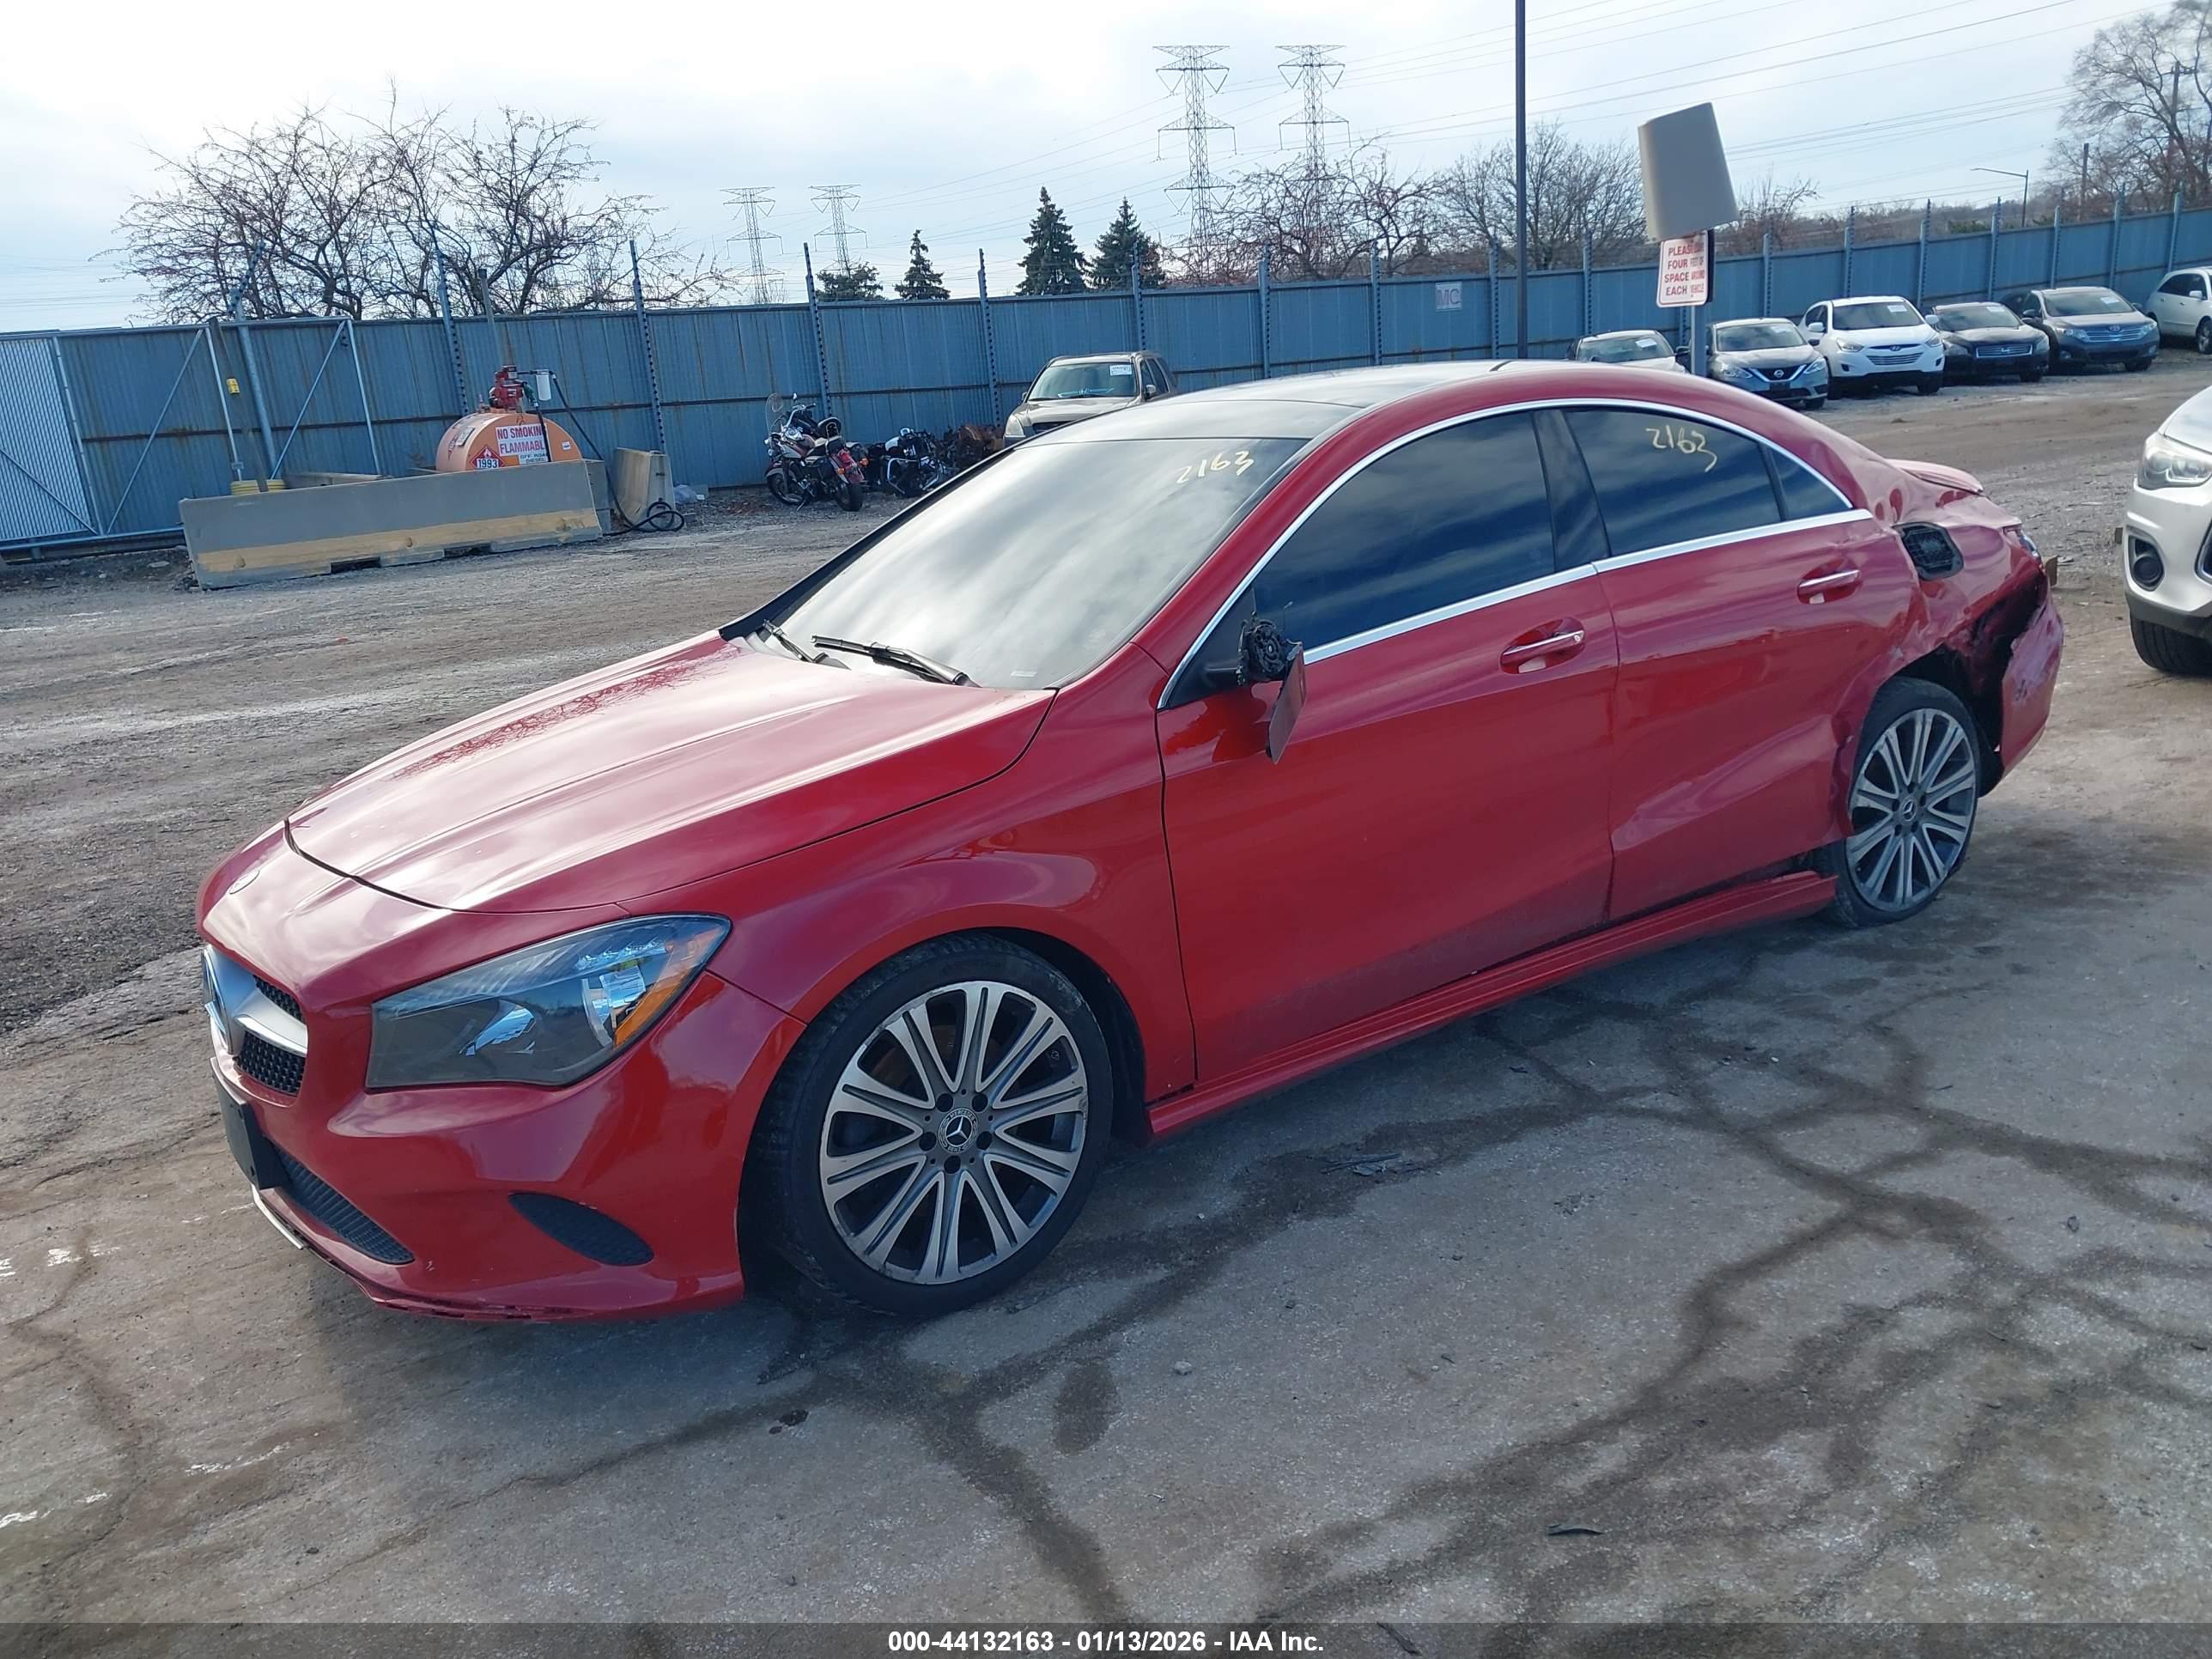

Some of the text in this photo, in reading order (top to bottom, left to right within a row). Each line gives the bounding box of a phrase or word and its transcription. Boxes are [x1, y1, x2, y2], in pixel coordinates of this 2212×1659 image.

[1668, 258, 1688, 270] FOUR
[1664, 272, 1689, 283] SPACE
[1666, 285, 1686, 295] EACH
[497, 425, 543, 441] NO SMOKIN
[499, 439, 545, 454] FLAMMABL
[1645, 424, 1717, 472] 2163
[477, 459, 497, 469] 1993
[1176, 450, 1255, 484] 2163
